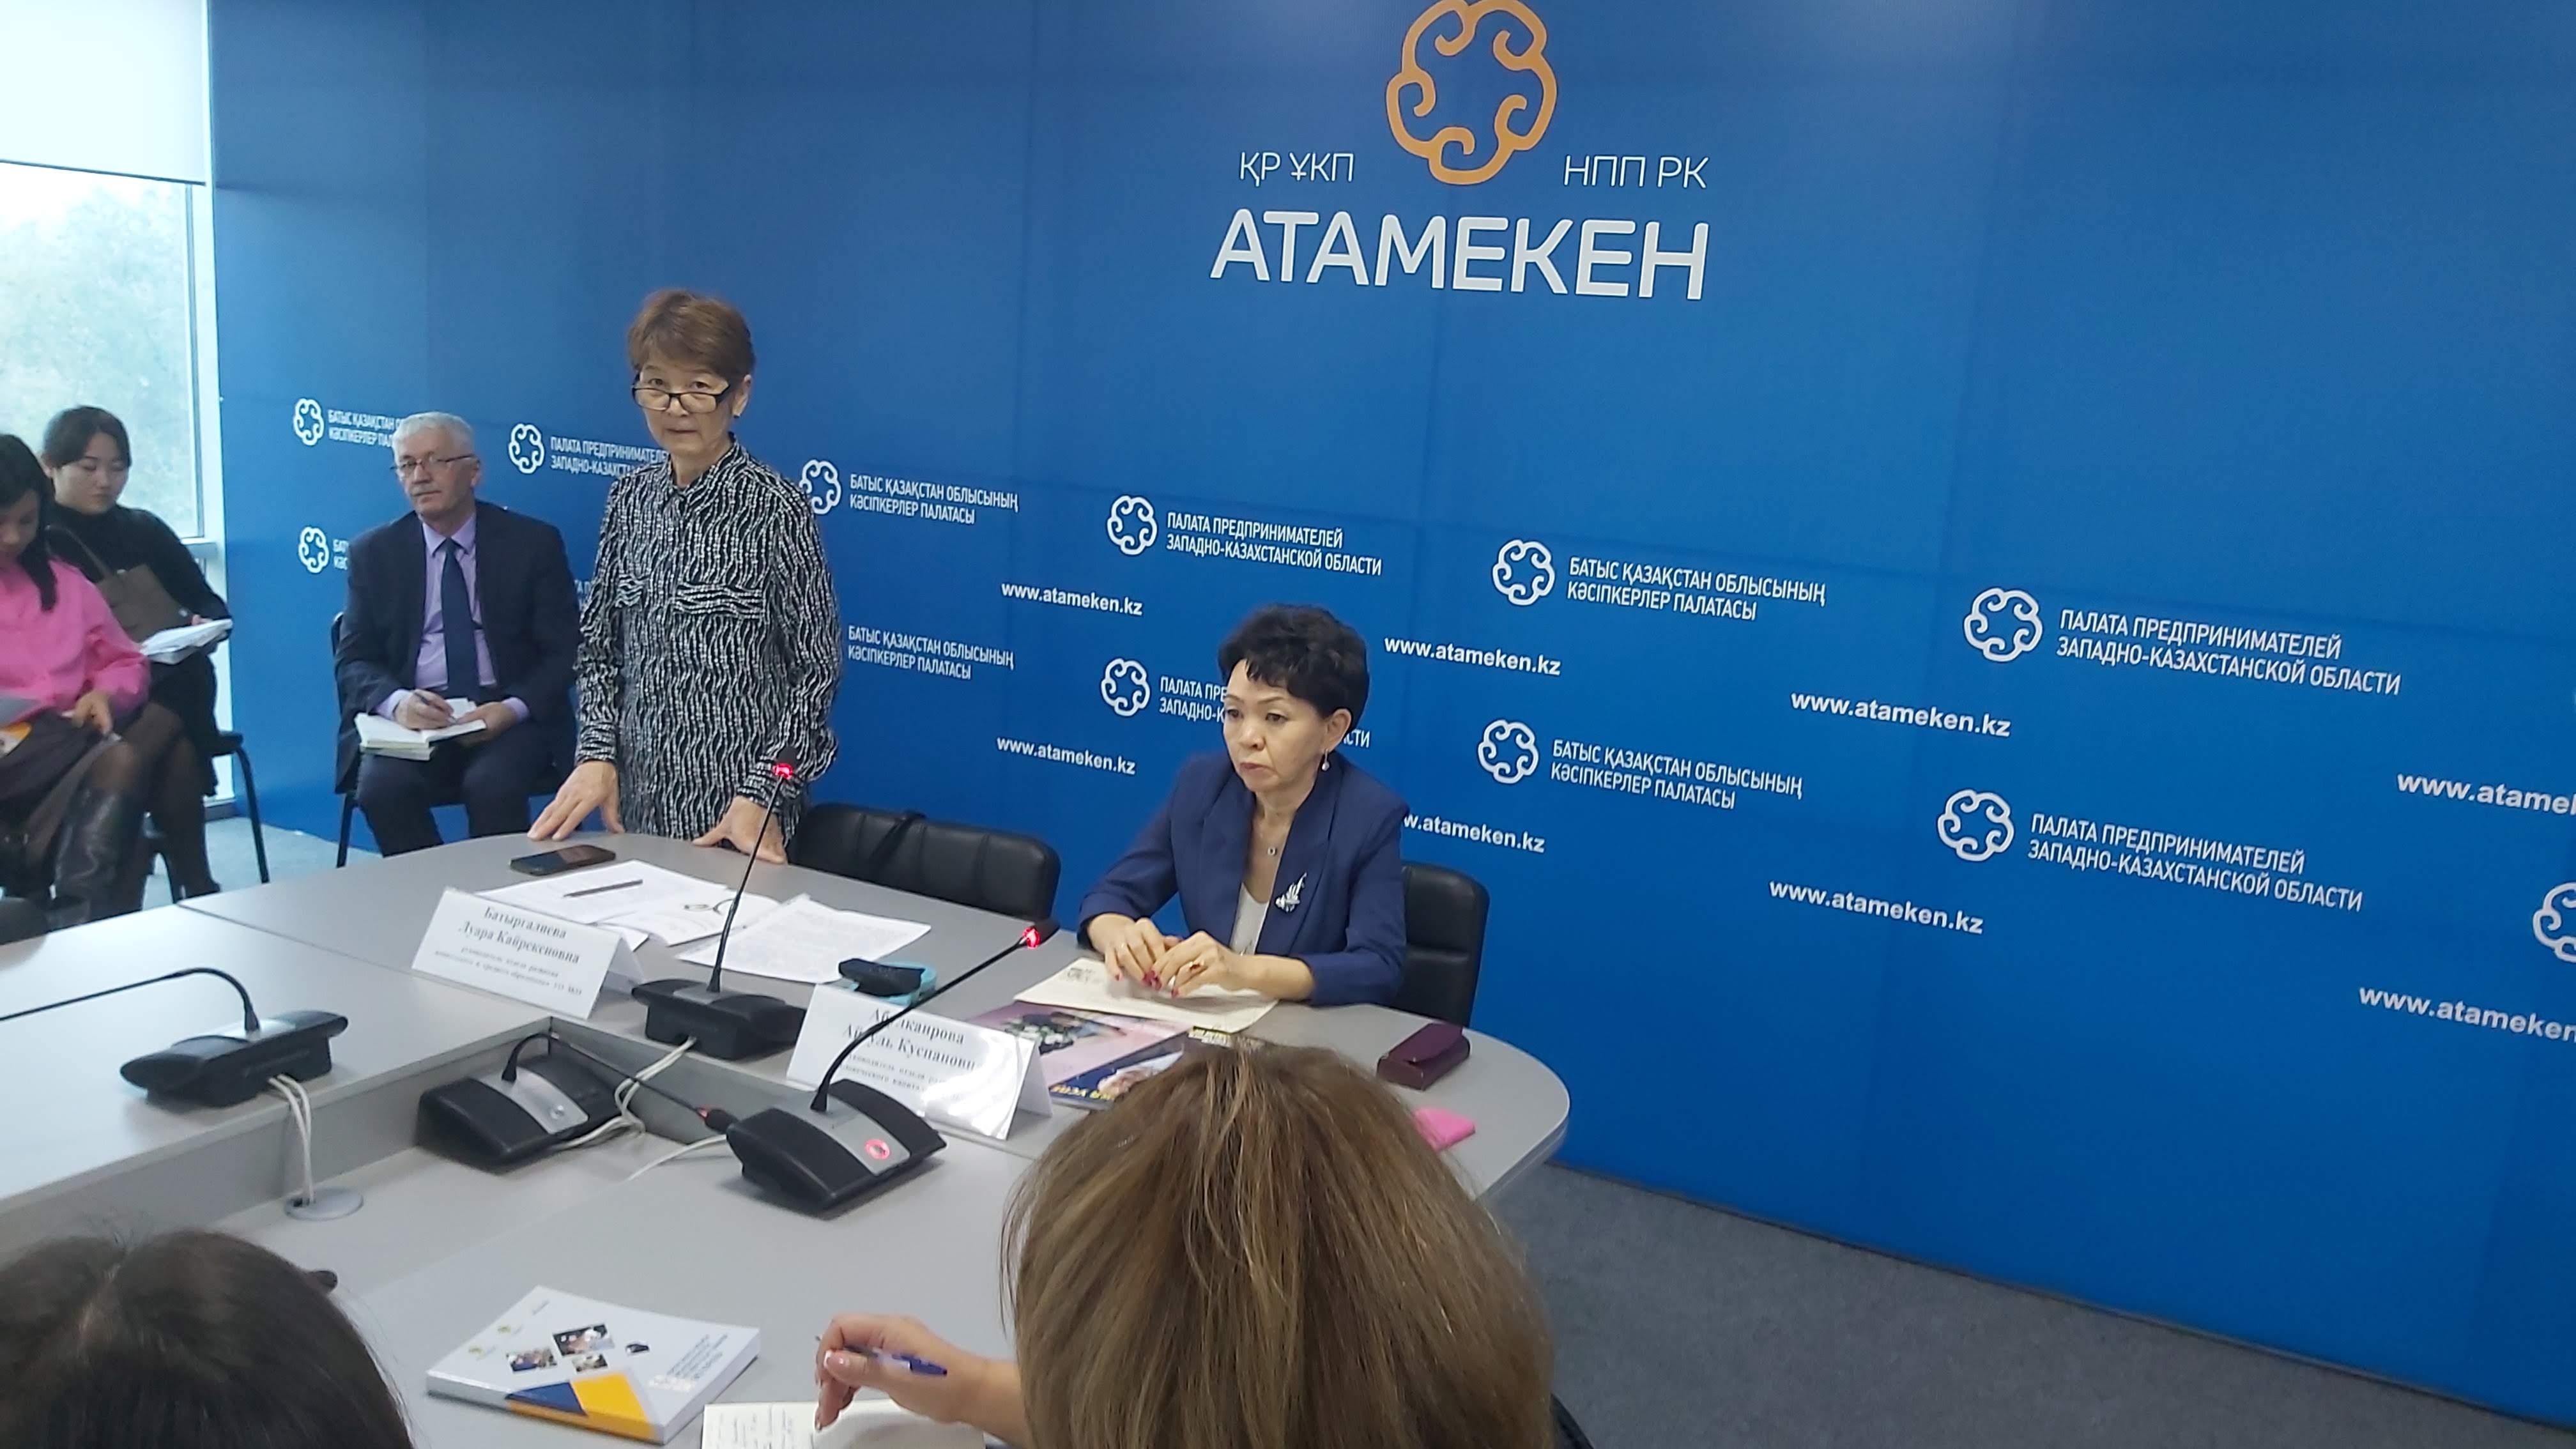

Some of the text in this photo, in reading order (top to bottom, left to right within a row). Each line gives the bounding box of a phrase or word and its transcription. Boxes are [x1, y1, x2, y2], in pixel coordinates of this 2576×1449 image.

[1239, 152, 1354, 186] ҚР ҰКП
[1563, 155, 1708, 188] НПП РК
[1209, 208, 1709, 300] АТАМЕКЕН
[549, 436, 670, 464] ПАЛАТА ПРЕДПРИНИМАТЕЛЕ
[850, 473, 1018, 513] БАТЫС ҚАЗАҚСТАН ОБЛЫСЫНЫҢ
[850, 493, 975, 525] КӘСІПКЕРЛЕР ПАЛАТАСЫ
[1167, 512, 1343, 549] ПАЛАТА ПРЕДПРИНИМАТЕЛЕЙ
[1166, 533, 1382, 576] ЗАПАДНО-КАЗАХСТАНСКОЙ ОБЛАСТИ
[1001, 583, 1142, 616] www.atameken.kz
[1567, 581, 1757, 620] КӘСІПКЕРЛЕР ПАЛАТАСЫ
[1570, 556, 1825, 607] БАТЫС ҚАЗАҚСТАН ОБЛЫСЫНЫҢ
[848, 625, 1014, 670] БАТЫС ҚАЗАҚСТАН ОБЛЫСЫНЫҢ
[2060, 609, 2342, 659] ПАЛАТА ПРЕДПРИНИМАТЕЛЕЙ
[848, 645, 971, 680] КӘСІПКЕРЛЕР ПАЛАТАСЫ
[1384, 638, 1561, 675] www.atameken.kz
[2056, 636, 2401, 695] ЗАПАДНО-КАЗАХСТАНСКОЙ ОБЛАСТИ
[1160, 676, 1227, 702] ПАЛАТА ПРЕ
[1159, 696, 1370, 748] ЗАПАДНО-К СТИ
[1791, 693, 2011, 737] www.atameken.kz
[997, 737, 1135, 775] www.atameken.kz
[1552, 739, 1802, 800] БАТЫС ҚАЗАҚСТАН ОБЛЫСЫНЫҢ
[1551, 762, 1735, 809] КӘСІПКЕРЛЕР ПАЛАТАСЫ
[1404, 814, 1545, 853] w.atameken.kz
[2031, 813, 2305, 875] ПАЛАТА ПРЕДПРИНИМАТЕЛЕЙ
[2027, 839, 2363, 912] ЗАПАДНО-КАЗАХСТАНСКОЙ ОБЛАСТИ
[484, 907, 567, 939] Батыргалиева
[1769, 881, 1984, 934] www.atameken.kz
[870, 1008, 965, 1045] Аблкаирова
[898, 1039, 976, 1071] Куспановн
